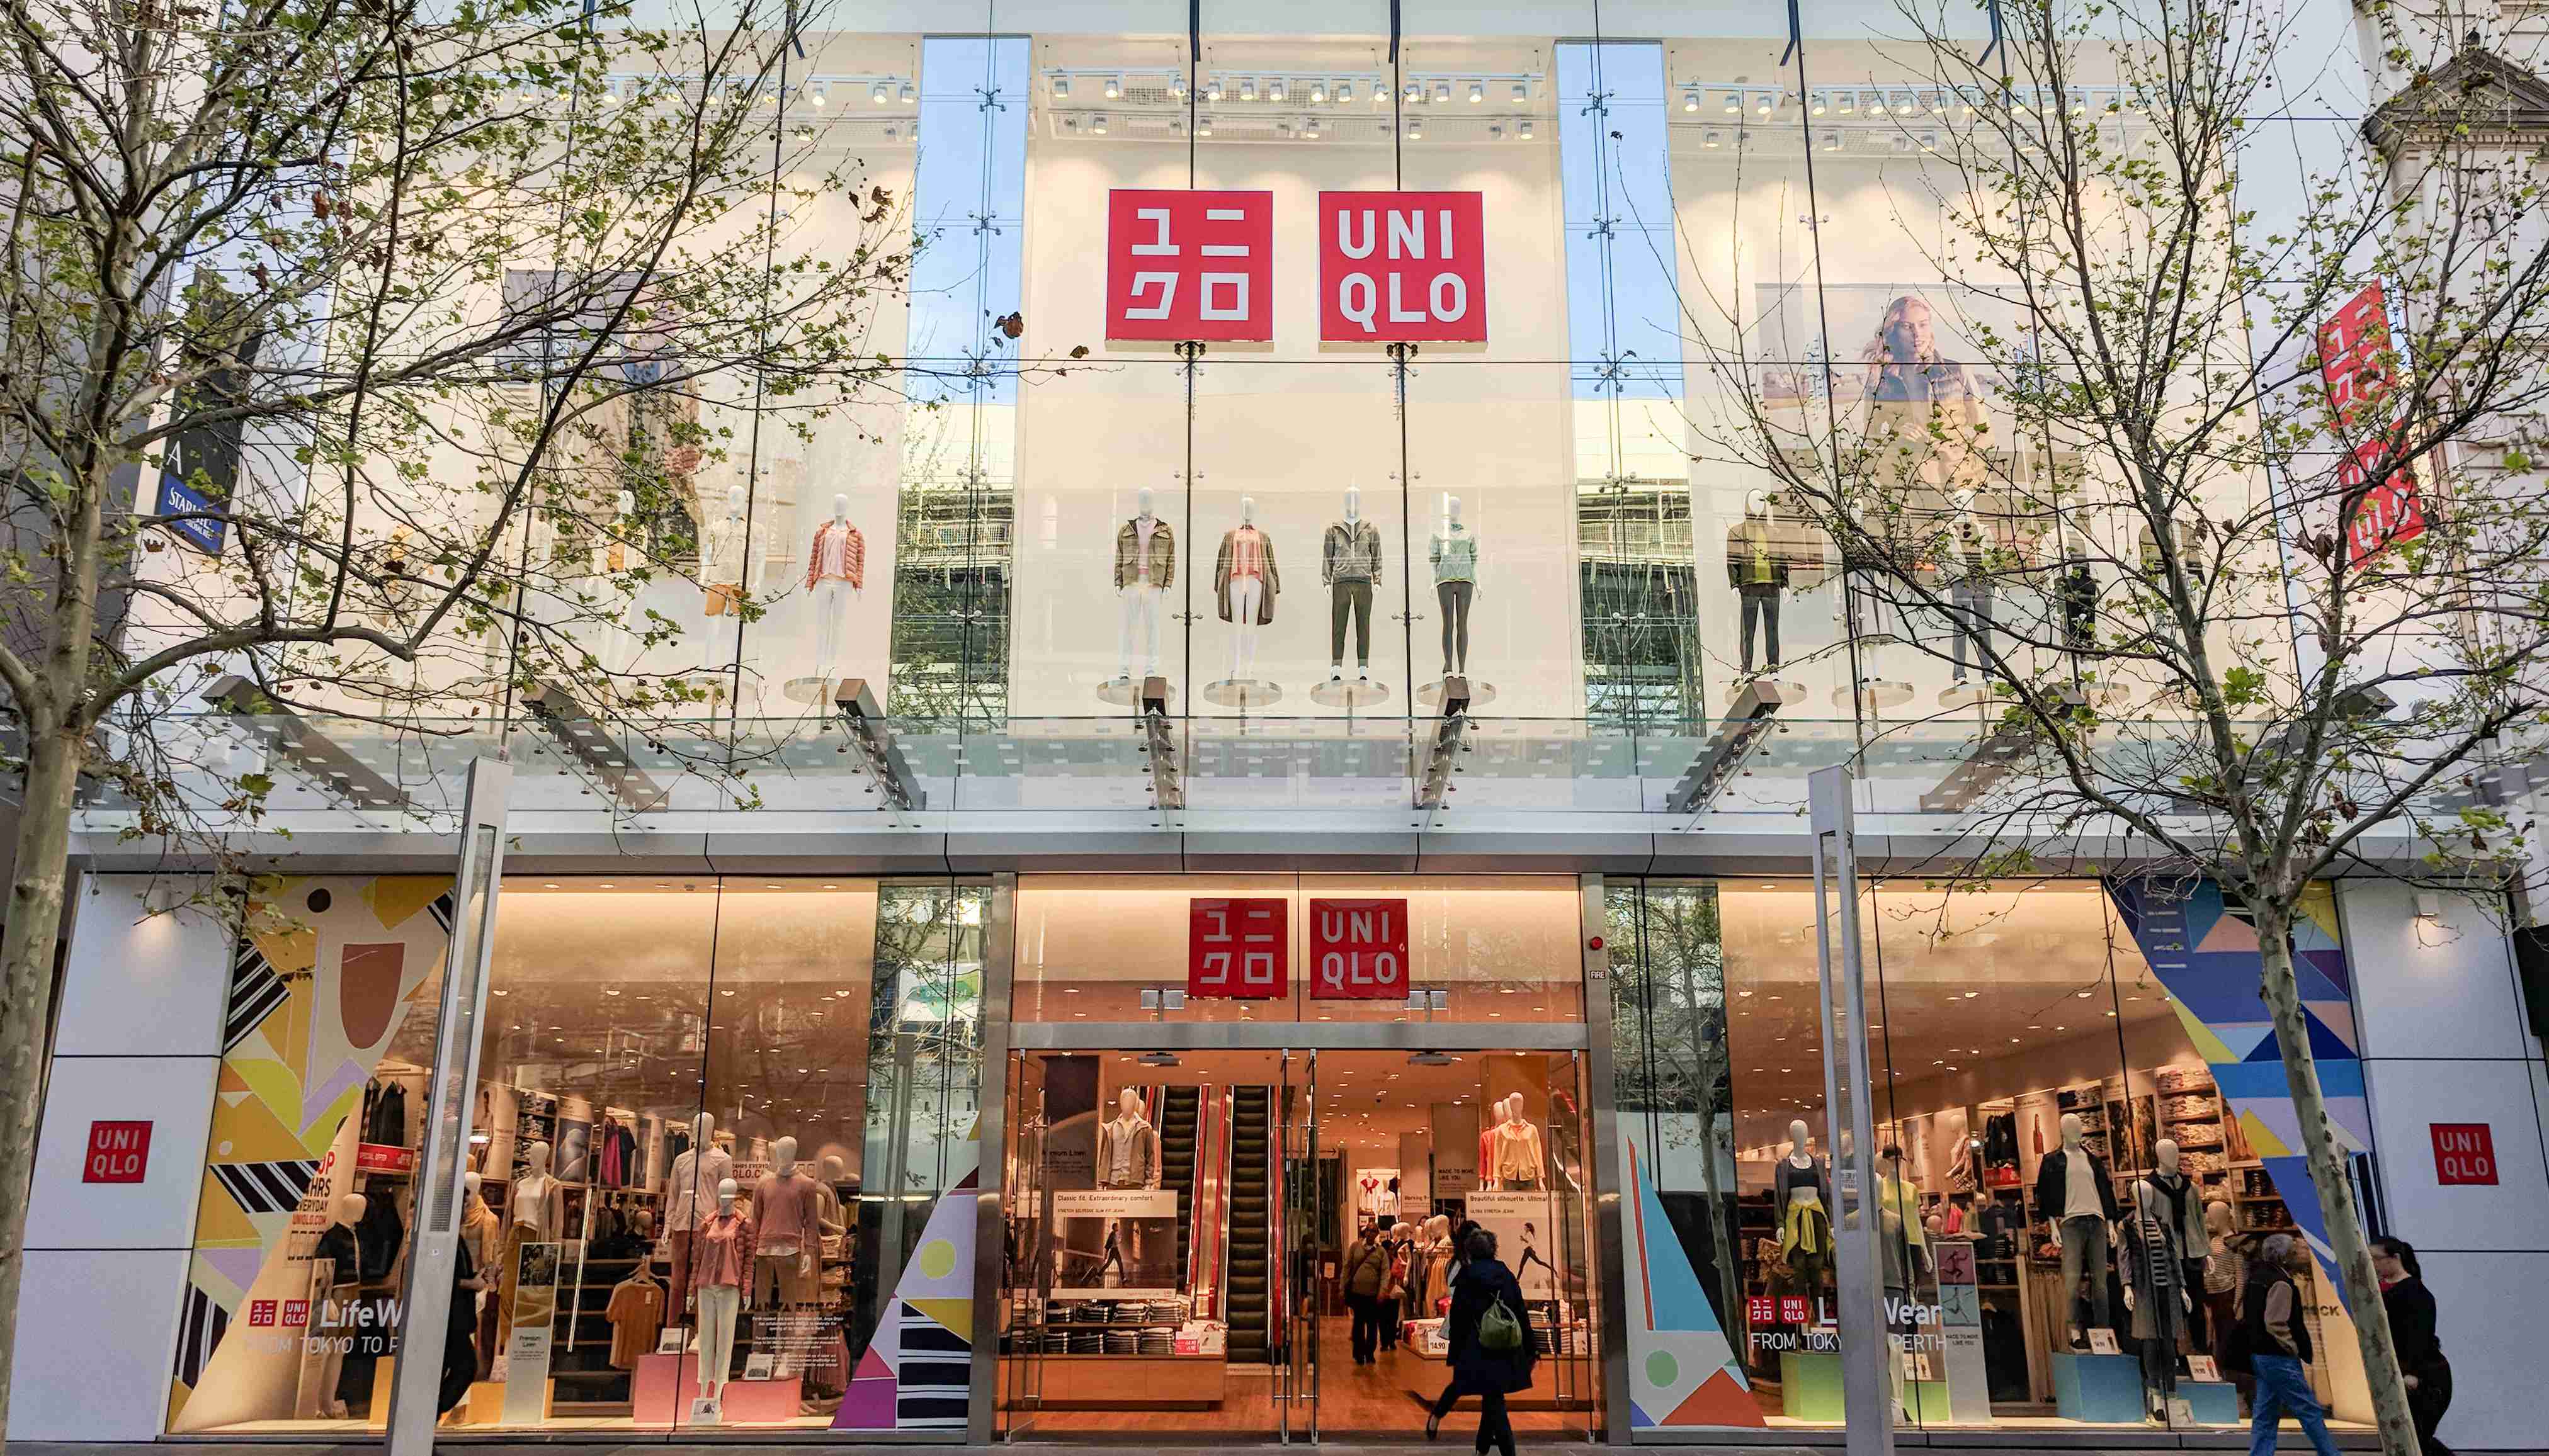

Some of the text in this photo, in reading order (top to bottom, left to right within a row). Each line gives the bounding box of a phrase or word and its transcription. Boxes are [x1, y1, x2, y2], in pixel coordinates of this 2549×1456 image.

[1131, 208, 1250, 257] ユニ
[1337, 209, 1454, 260] UNI
[1123, 271, 1250, 321] クロ
[1338, 272, 1468, 334] QLO
[1203, 910, 1274, 942] ユニ
[1322, 911, 1390, 944] UNI
[1200, 952, 1274, 984] クロ
[1322, 951, 1398, 991] QLO
[96, 1129, 140, 1149] UNI
[2439, 1131, 2482, 1153] UNI
[92, 1154, 140, 1178] QLO
[2444, 1156, 2489, 1179] QLO
[309, 1178, 332, 1197] HRS
[287, 1302, 307, 1312] UNI
[320, 1299, 404, 1328] LifeW
[1783, 1299, 1803, 1309] UNI
[285, 1313, 305, 1324] QLO
[1784, 1311, 1805, 1321] QLO
[300, 1336, 354, 1354] TOKYO
[361, 1336, 383, 1353] TO
[1750, 1333, 1947, 1350] FROM TOKY PERTH
